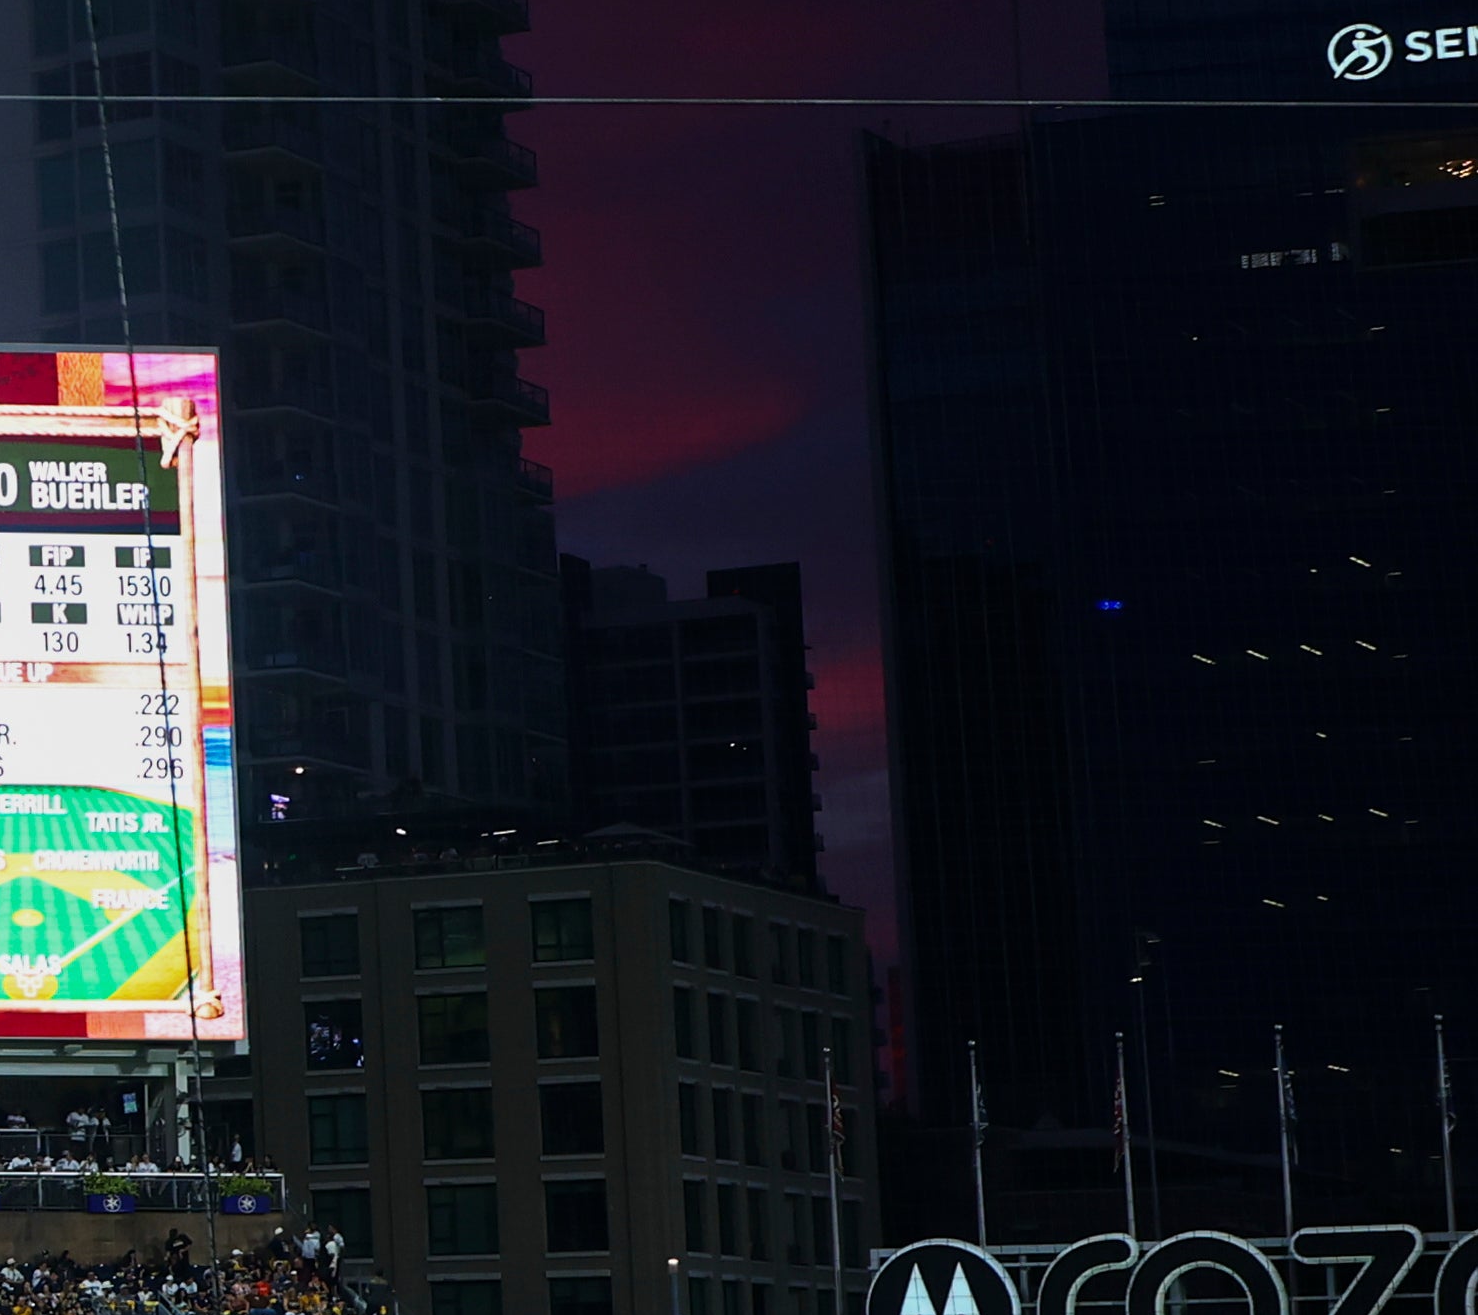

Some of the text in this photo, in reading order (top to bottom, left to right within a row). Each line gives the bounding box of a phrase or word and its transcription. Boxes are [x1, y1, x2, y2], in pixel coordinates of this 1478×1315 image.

[29, 461, 107, 483] WALKER
[31, 483, 149, 511] BUEHLER
[85, 813, 138, 833] TATIS
